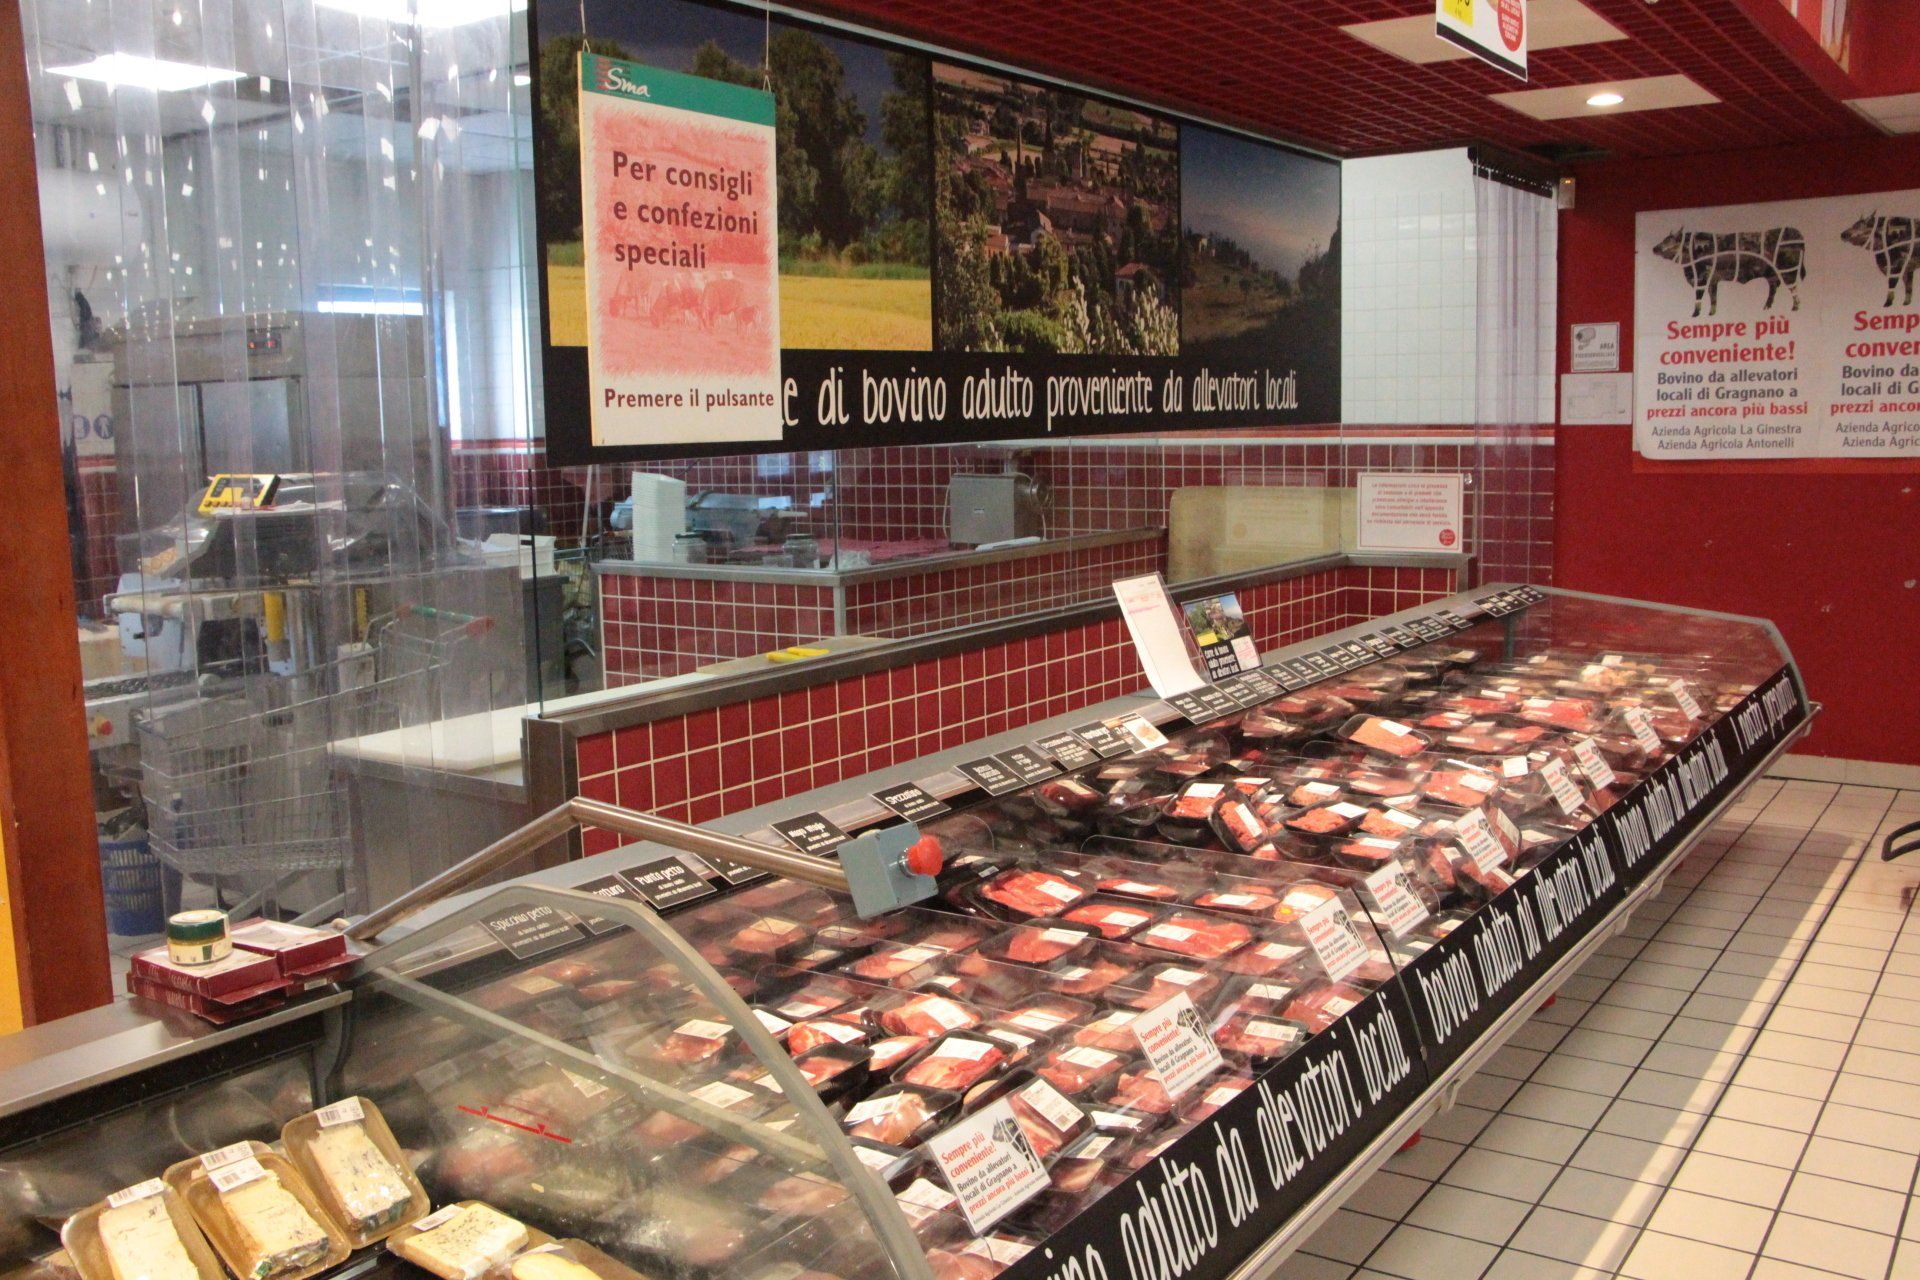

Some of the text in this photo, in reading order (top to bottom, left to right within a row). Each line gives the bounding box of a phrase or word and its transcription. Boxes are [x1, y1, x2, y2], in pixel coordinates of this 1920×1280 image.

[604, 67, 650, 97] Sma
[613, 151, 753, 200] Per consigli
[613, 200, 758, 235] e confezioni
[614, 240, 706, 271] speciali
[1667, 315, 1790, 341] Sempre più
[1854, 310, 1920, 333] Semp
[1660, 340, 1795, 366] conveniente!
[1657, 367, 1798, 385] Bovino da allevatori
[1842, 363, 1919, 379] Bovino da
[604, 387, 775, 413] Premere il pulsante
[818, 366, 849, 426] di
[863, 366, 947, 425] bovino
[962, 365, 1034, 419] adulto
[1047, 368, 1153, 432] proveniente
[1162, 369, 1183, 413] da
[1192, 367, 1260, 413] allevatori
[1265, 368, 1298, 410] locali
[1656, 386, 1798, 401] locali di Gragnano a
[1841, 382, 1881, 396] locali
[1887, 381, 1901, 395] di
[1647, 401, 1808, 421] prezzi ancora più bassi
[1830, 400, 1874, 416] prezzi
[1652, 423, 1802, 438] Azienda Agricola La Ginestra
[1836, 421, 1920, 434] Azienda Agrico
[1657, 437, 1794, 451] Azienda Agricola Antonelli
[1842, 436, 1920, 449] Azienda Agric
[1611, 799, 1651, 868] bovino
[1644, 776, 1675, 843] adulto
[1664, 767, 1686, 821] da
[1675, 754, 1715, 811] allevatori
[1701, 728, 1729, 785] locali
[634, 864, 686, 886] Punta petto
[489, 904, 552, 932] Spicchio petto
[1416, 945, 1479, 1044] bovino
[1473, 904, 1523, 998] adulto
[1513, 889, 1542, 960] da
[1534, 844, 1592, 942] allevatori
[1577, 823, 1616, 900] locali
[1140, 1025, 1163, 1042] Sempre
[940, 1131, 986, 1165] Sempre più
[1120, 1157, 1218, 1280] adulto
[1213, 1121, 1259, 1228] da
[1255, 1031, 1363, 1191] allevatori
[1346, 991, 1412, 1105] locali
[950, 1140, 997, 1178] conveniente!
[957, 1151, 1012, 1193] Bovino da allevatori
[963, 1162, 1018, 1203] locali di Gragnano a
[968, 1166, 1030, 1214] prezzi ancora più bassi
